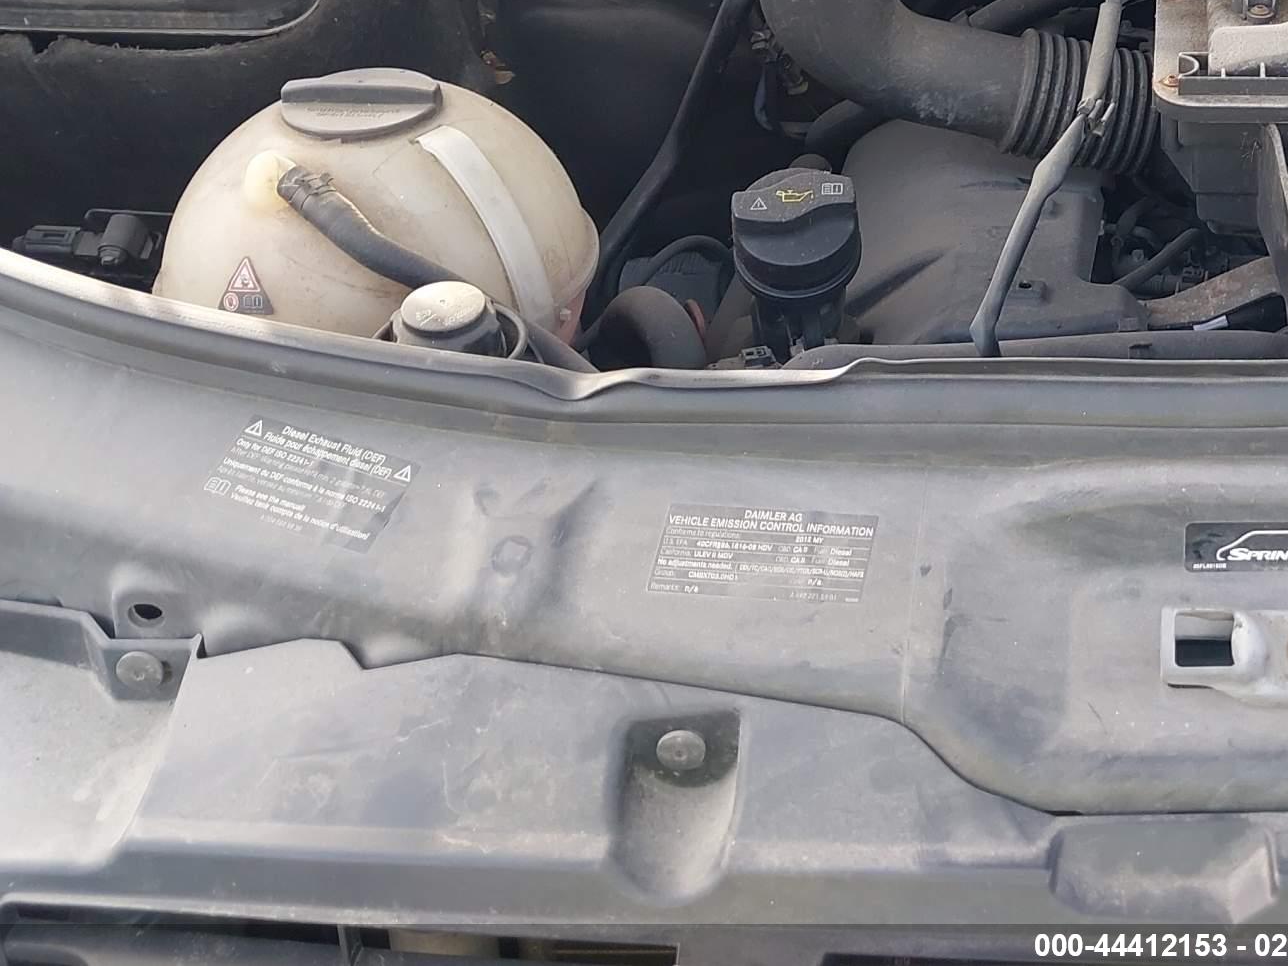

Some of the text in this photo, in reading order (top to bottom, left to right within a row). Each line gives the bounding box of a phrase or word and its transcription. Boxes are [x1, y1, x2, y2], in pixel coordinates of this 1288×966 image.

[237, 438, 250, 449] Only
[261, 446, 275, 454] DEF
[274, 450, 287, 459] ISO
[264, 432, 286, 445] Fluide
[283, 440, 302, 450] pour
[370, 465, 392, 479] (DEF)
[282, 426, 386, 465] Diesel Exhaust Fluid (DEF)
[670, 514, 873, 536] VEHICLE EMISSION CONTROL INFORMATION
[745, 510, 802, 522] DAIMLER AG
[828, 558, 849, 566] Diesel
[830, 548, 852, 556] Diesel
